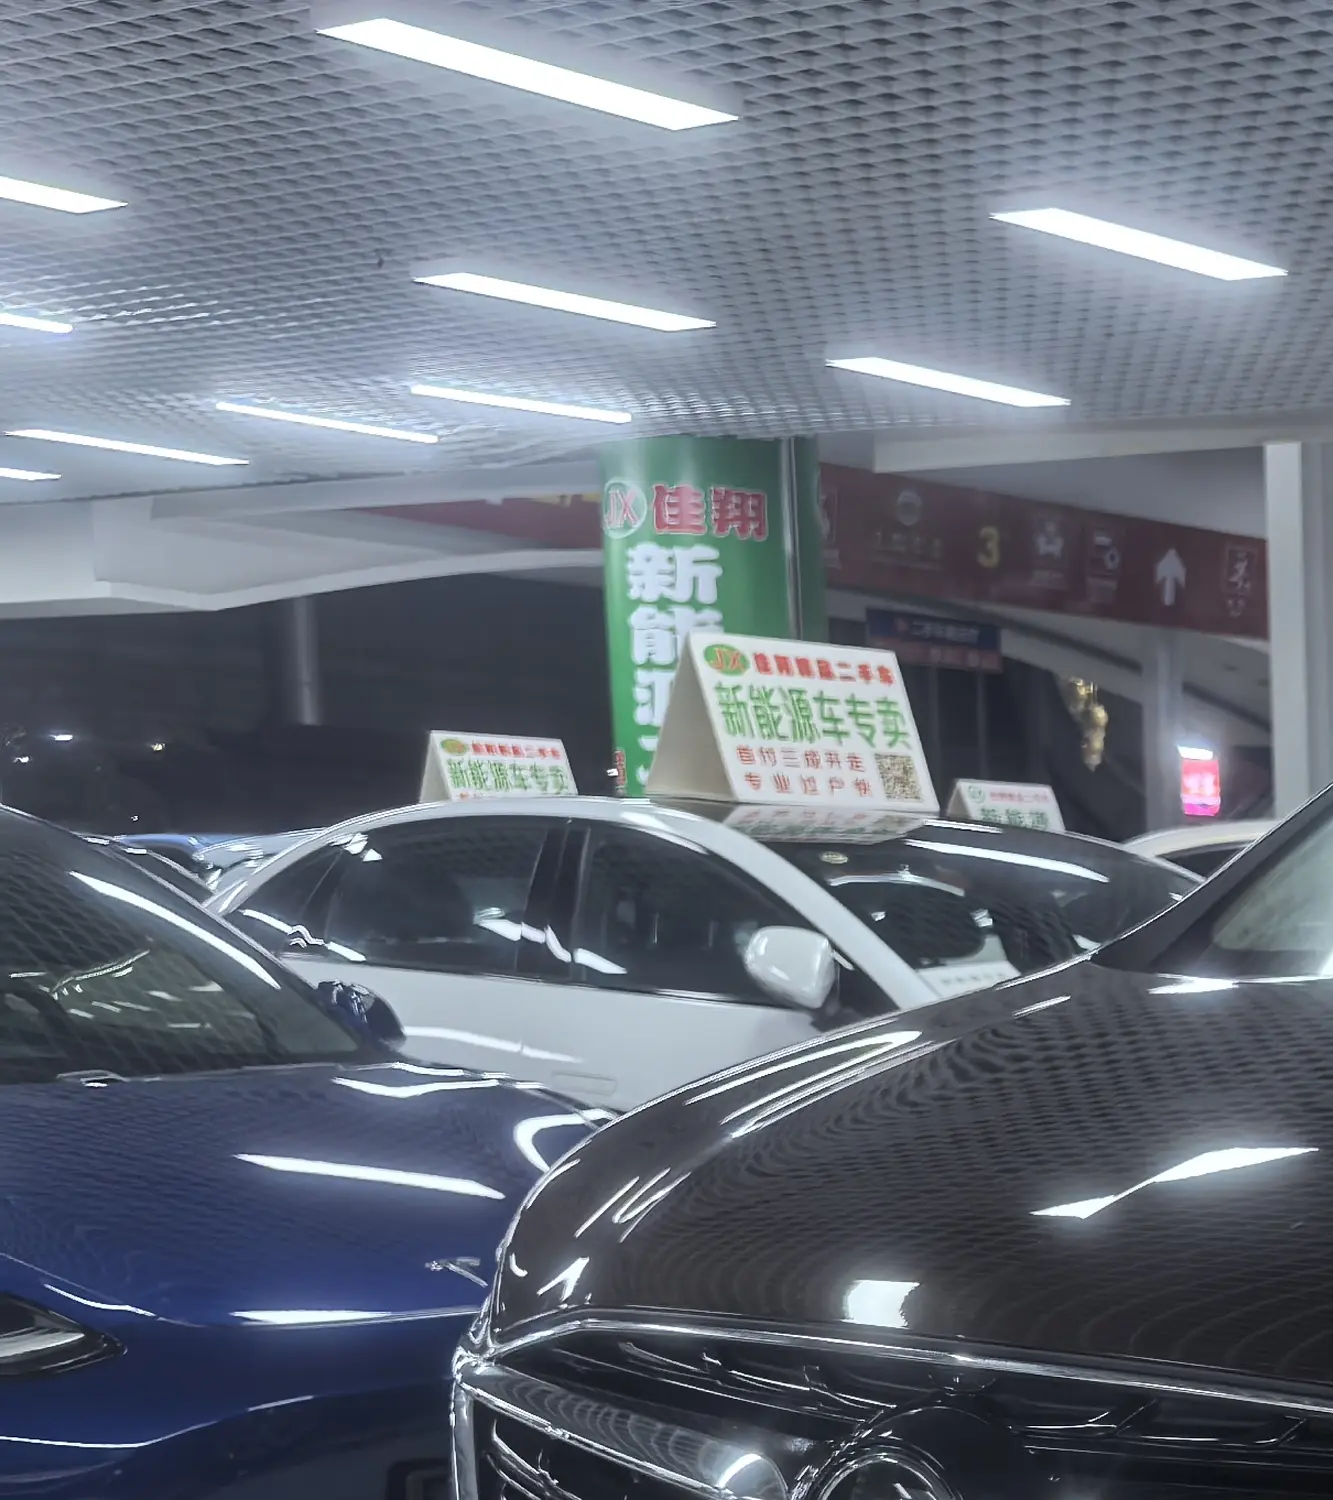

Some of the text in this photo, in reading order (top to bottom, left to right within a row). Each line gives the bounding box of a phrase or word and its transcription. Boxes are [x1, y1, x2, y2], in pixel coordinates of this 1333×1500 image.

[652, 483, 768, 541] 佳翔
[714, 680, 912, 749] 新能源车专卖
